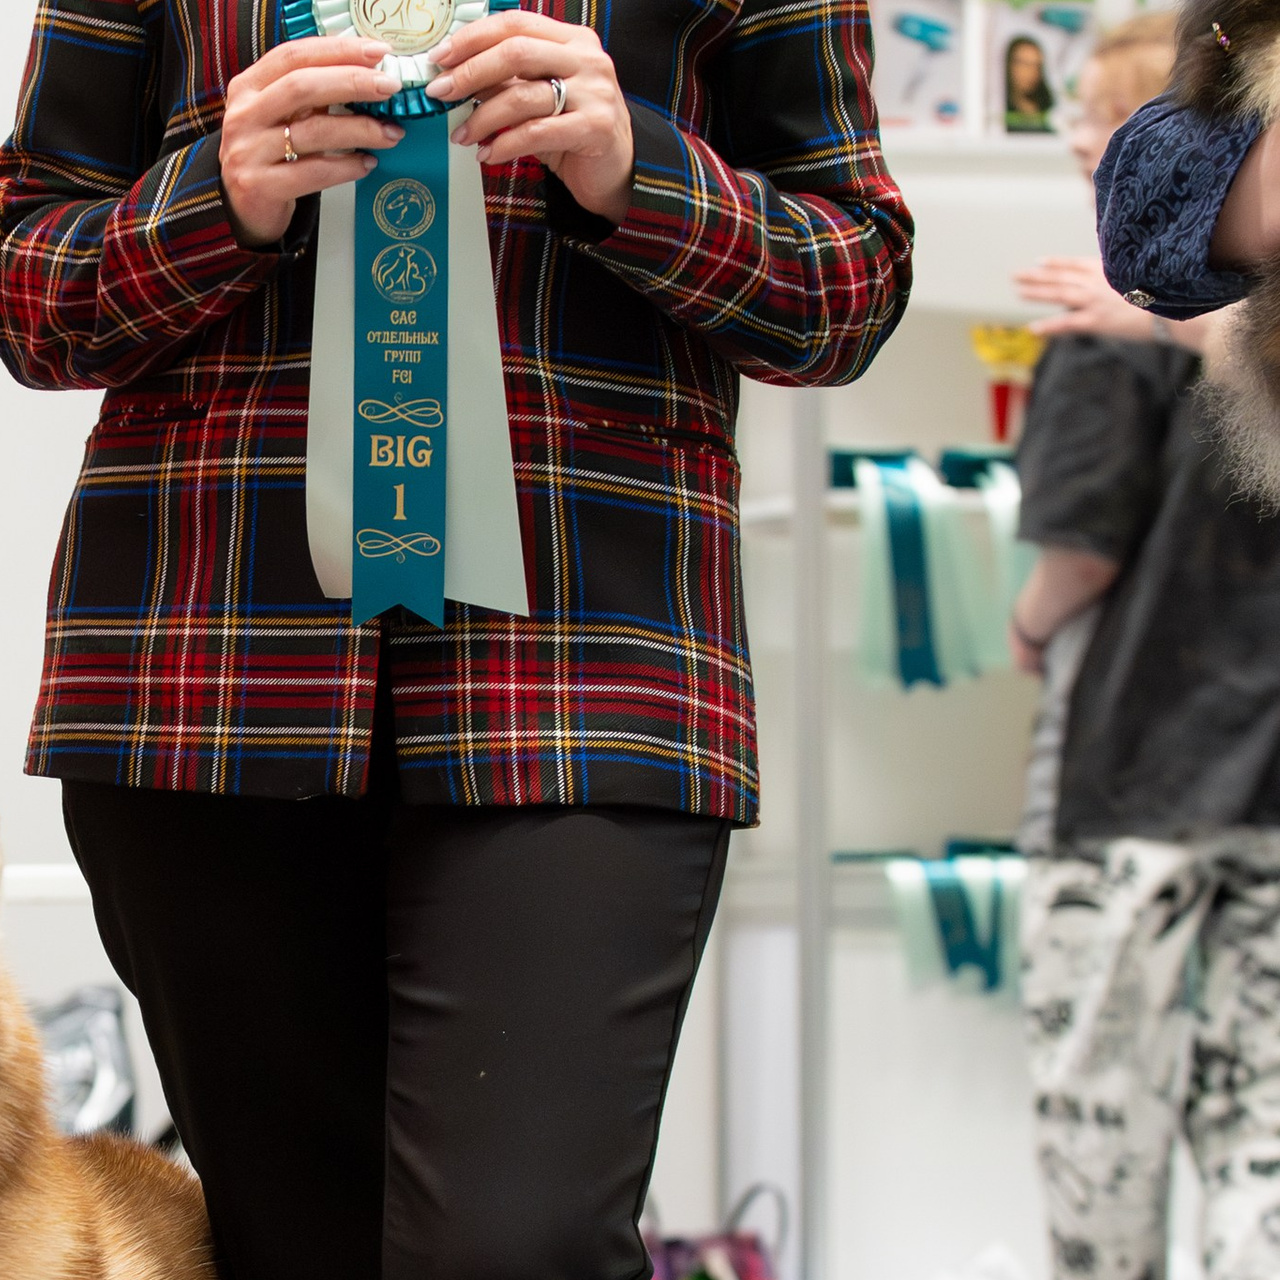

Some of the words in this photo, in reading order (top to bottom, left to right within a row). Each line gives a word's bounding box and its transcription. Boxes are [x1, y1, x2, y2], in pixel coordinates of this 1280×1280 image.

[367, 330, 439, 345] ОТДЕЛЬНЫХ
[384, 349, 422, 363] ГРУПП
[392, 369, 413, 384] FCI
[368, 434, 434, 468] BIG
[392, 483, 408, 521] 1
